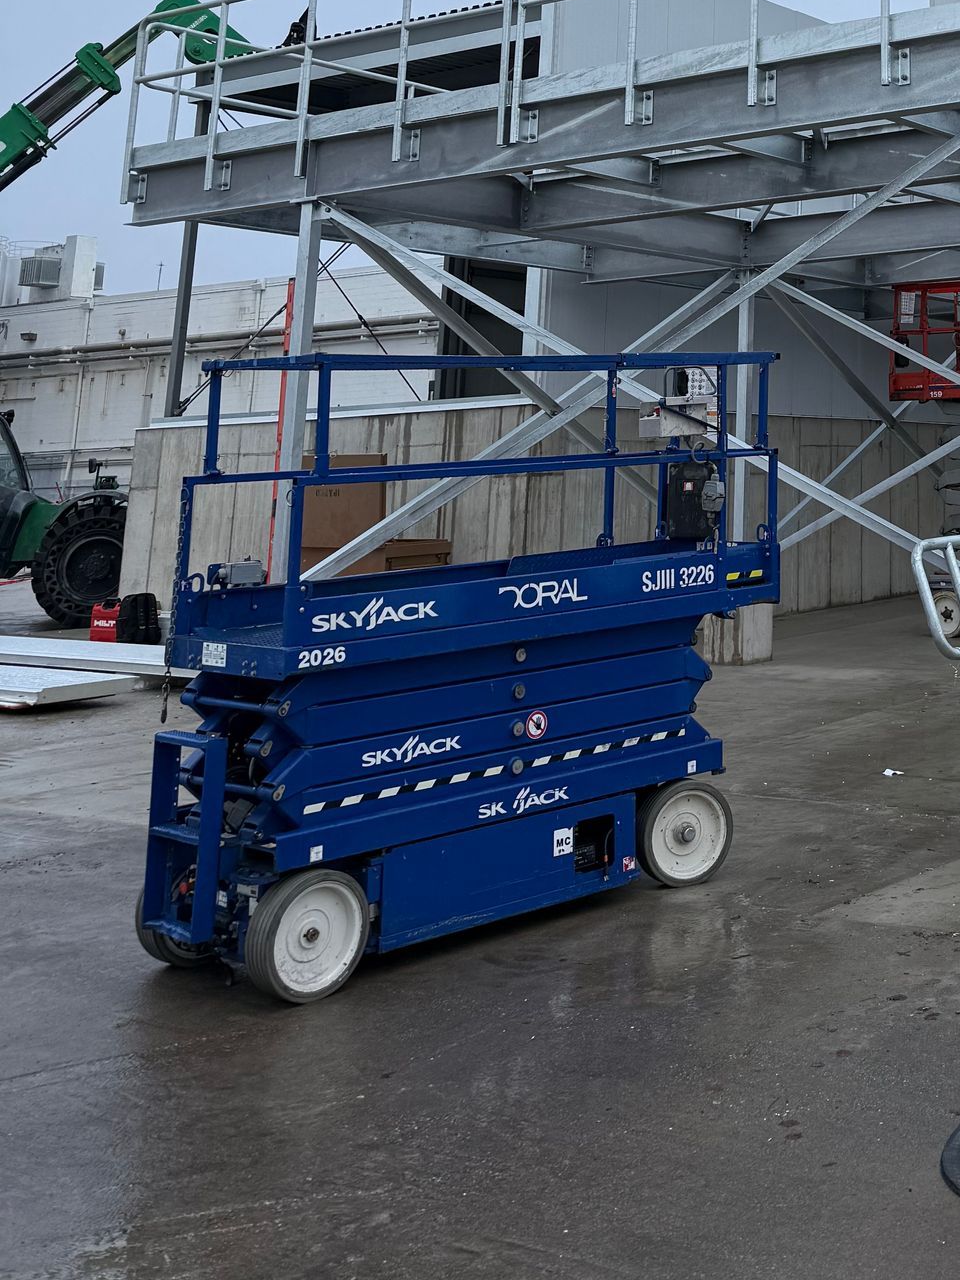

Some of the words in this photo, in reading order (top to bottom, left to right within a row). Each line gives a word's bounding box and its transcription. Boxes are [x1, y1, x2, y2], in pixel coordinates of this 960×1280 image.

[679, 563, 715, 588] 3226
[498, 577, 588, 609] DORAL
[311, 596, 439, 633] SKYJACK
[298, 646, 346, 669] 2026
[361, 734, 462, 767] SKYJACK
[556, 836, 571, 849] MC
